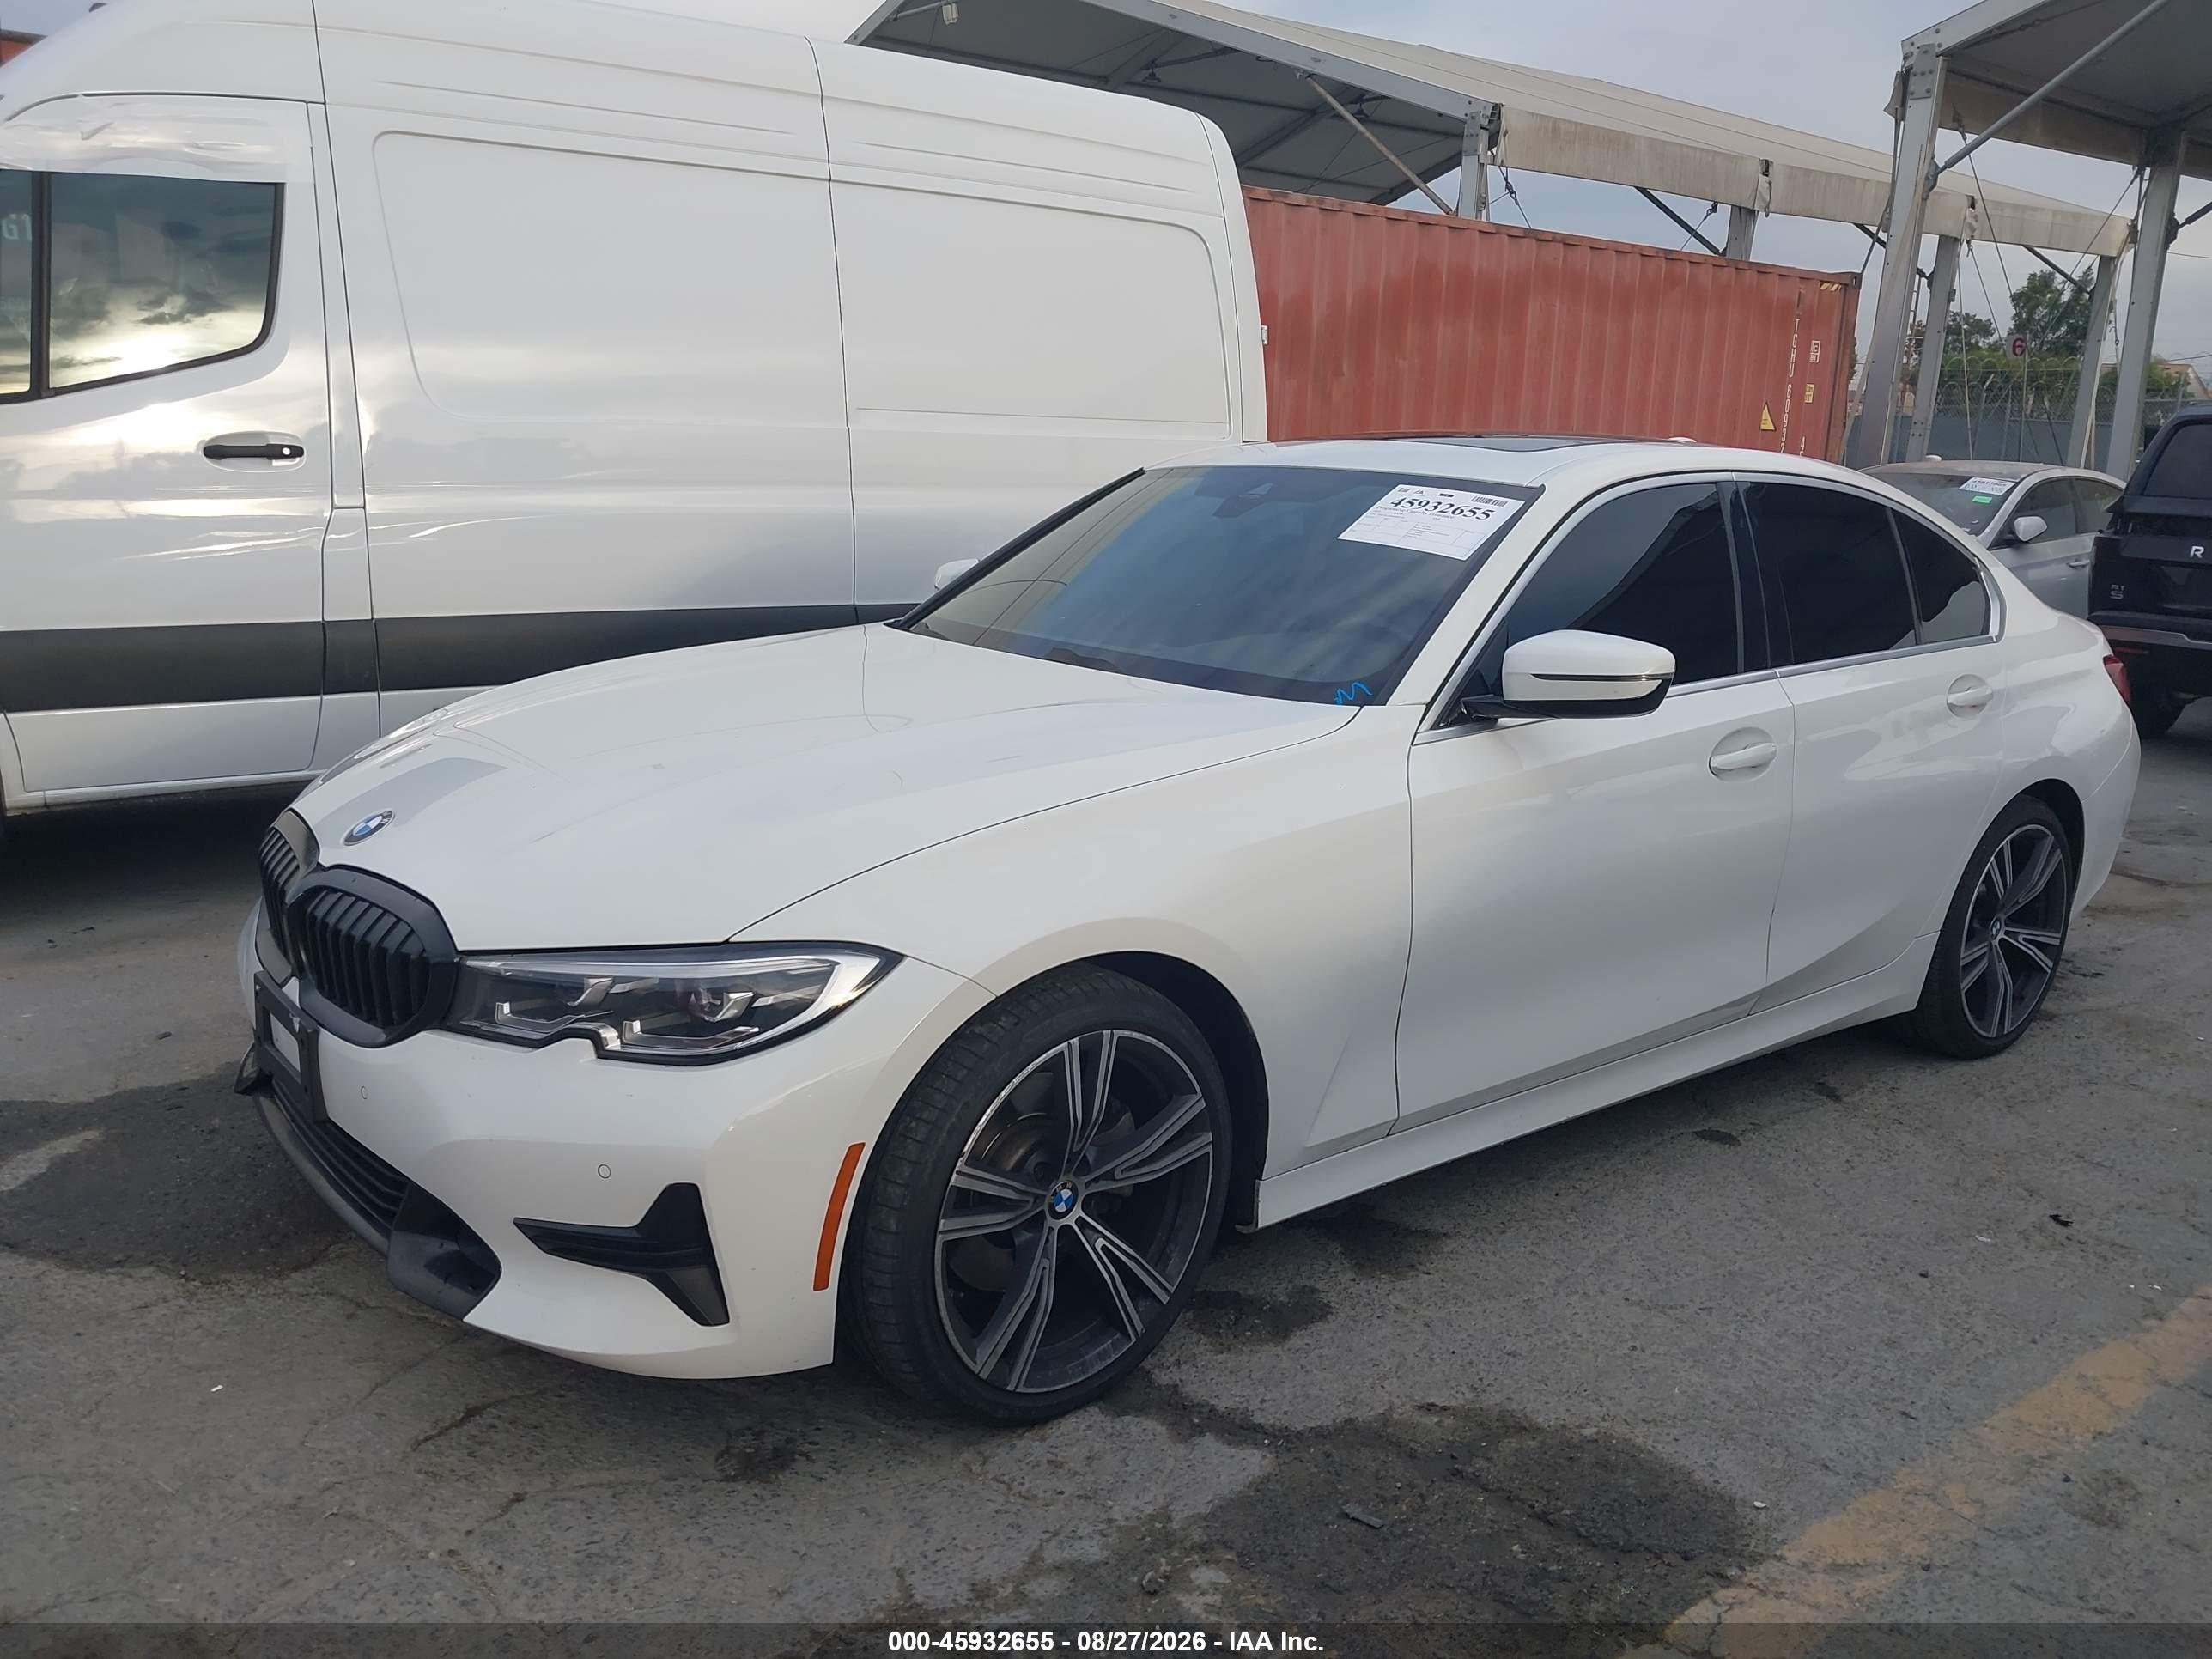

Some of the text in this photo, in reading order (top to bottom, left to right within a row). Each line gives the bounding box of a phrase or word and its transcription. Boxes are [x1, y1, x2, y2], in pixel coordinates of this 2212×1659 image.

[1789, 318, 1801, 378] TGHU
[2012, 337, 2026, 357] 6
[1390, 497, 1496, 520] 45932655
[2190, 545, 2205, 558] R
